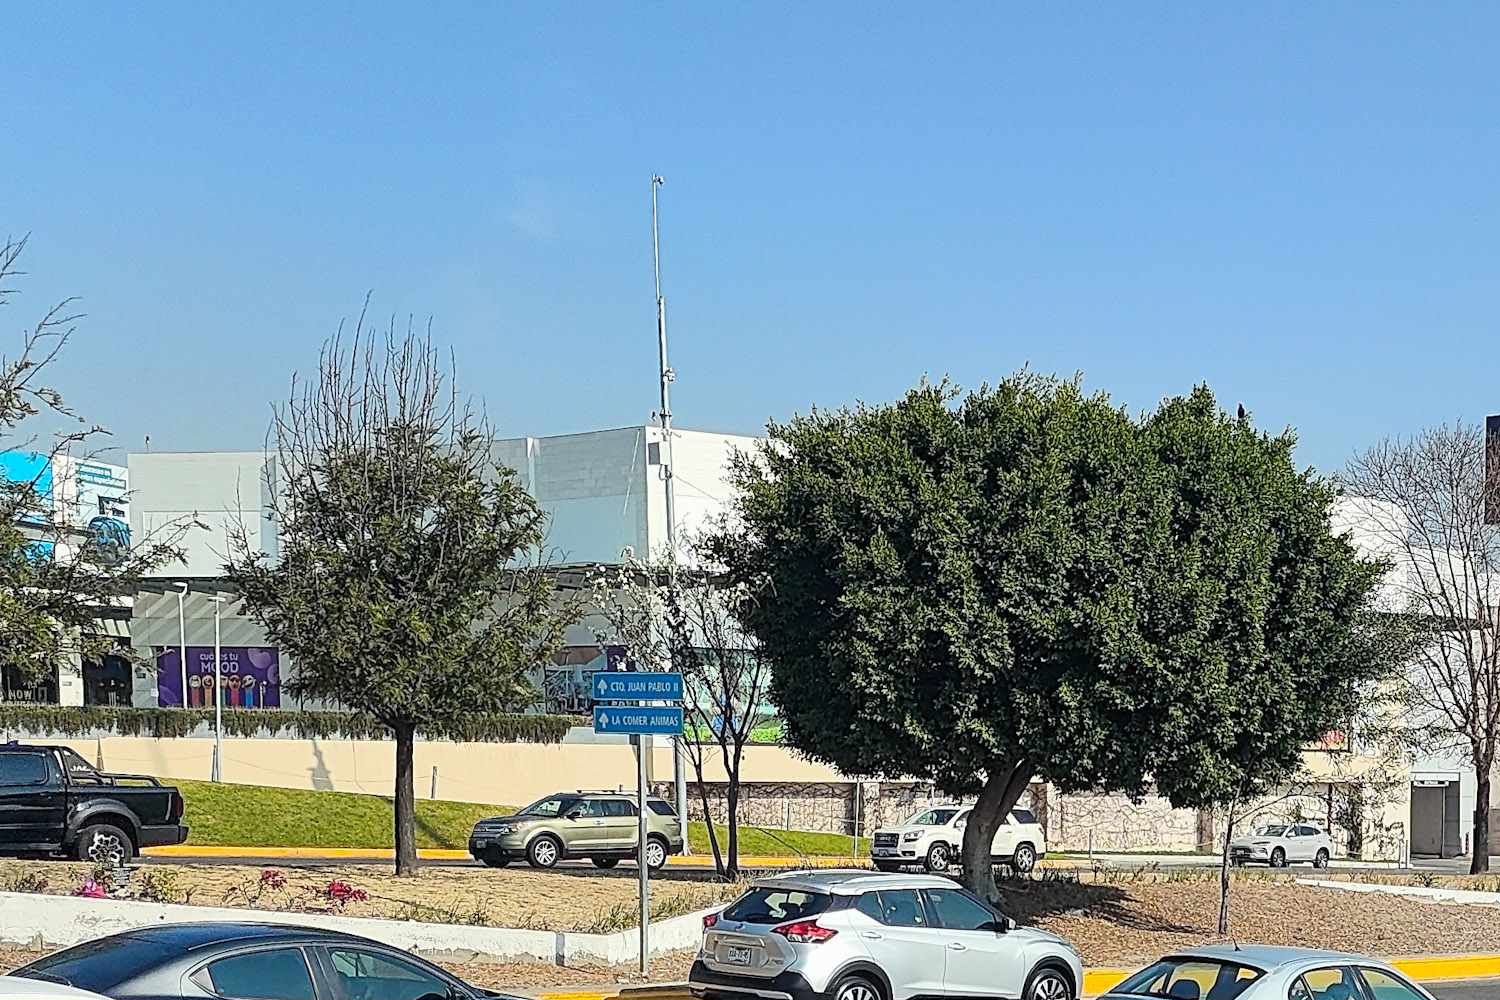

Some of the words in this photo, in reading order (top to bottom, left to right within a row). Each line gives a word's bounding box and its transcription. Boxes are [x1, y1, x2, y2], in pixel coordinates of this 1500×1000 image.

[200, 652, 214, 661] cuá
[628, 682, 646, 692] JUAN
[648, 682, 670, 692] PABLO
[674, 682, 679, 692] II
[612, 716, 620, 726] LA
[622, 716, 648, 726] COMER
[650, 716, 679, 726] ANIMAS
